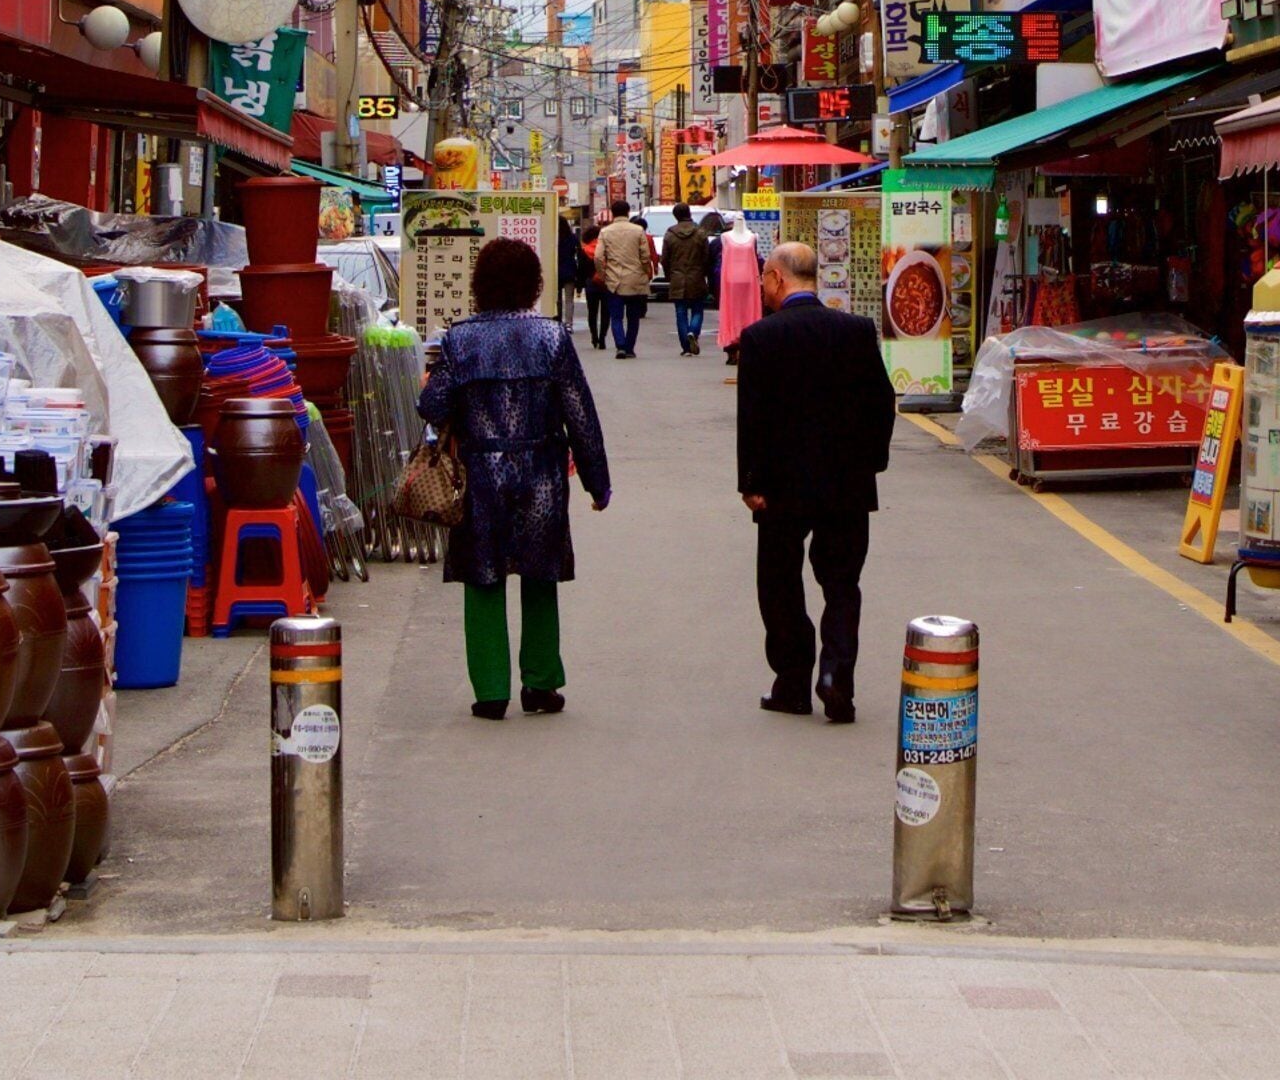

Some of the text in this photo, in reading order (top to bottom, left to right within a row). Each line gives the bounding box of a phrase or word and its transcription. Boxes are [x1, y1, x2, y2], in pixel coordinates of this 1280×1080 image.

[885, 1, 908, 52] 호프
[891, 200, 943, 216] 팥칼국수
[1037, 379, 1093, 409] 털실
[905, 700, 949, 720] 운전면허
